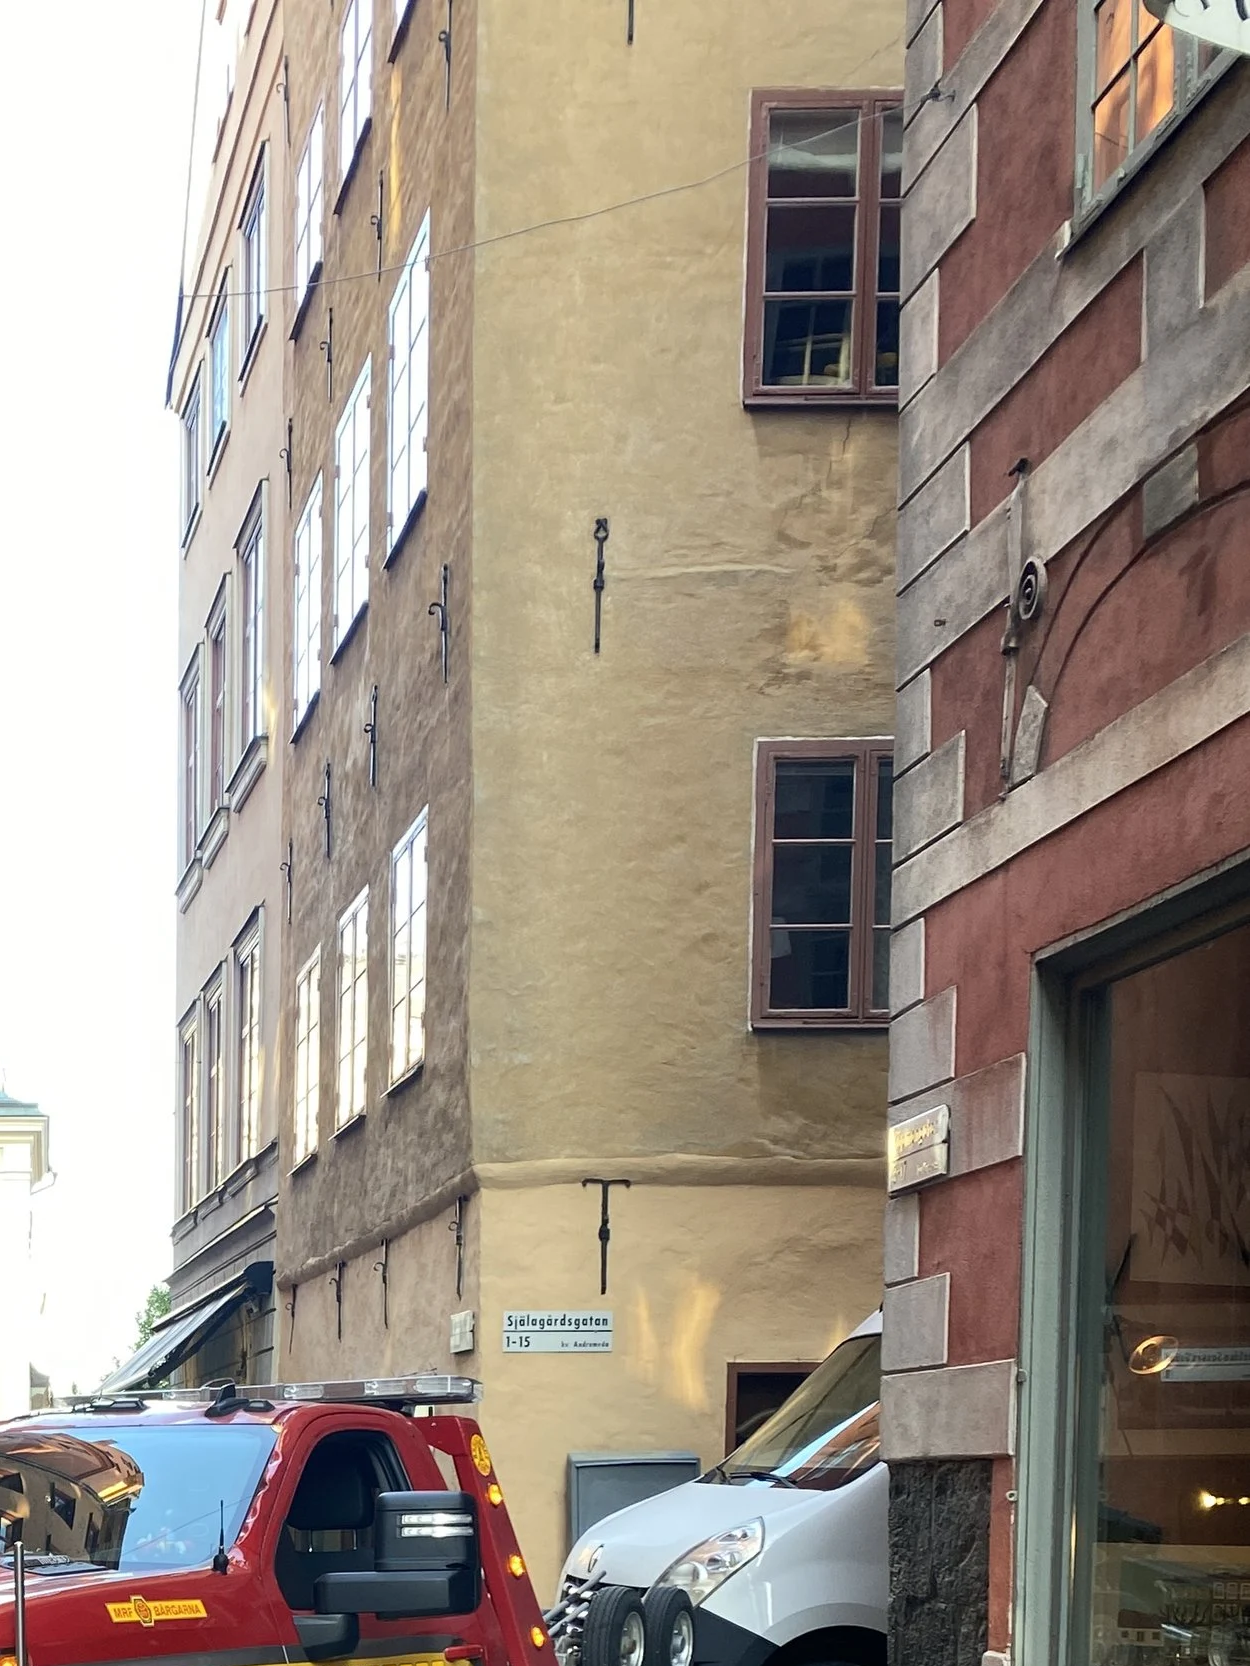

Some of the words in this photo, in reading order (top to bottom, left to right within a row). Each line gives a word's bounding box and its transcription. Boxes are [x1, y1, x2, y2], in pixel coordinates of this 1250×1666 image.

[506, 1313, 609, 1331] Själagårdsgatan
[505, 1335, 531, 1349] 1-15
[113, 1606, 134, 1619] MRF
